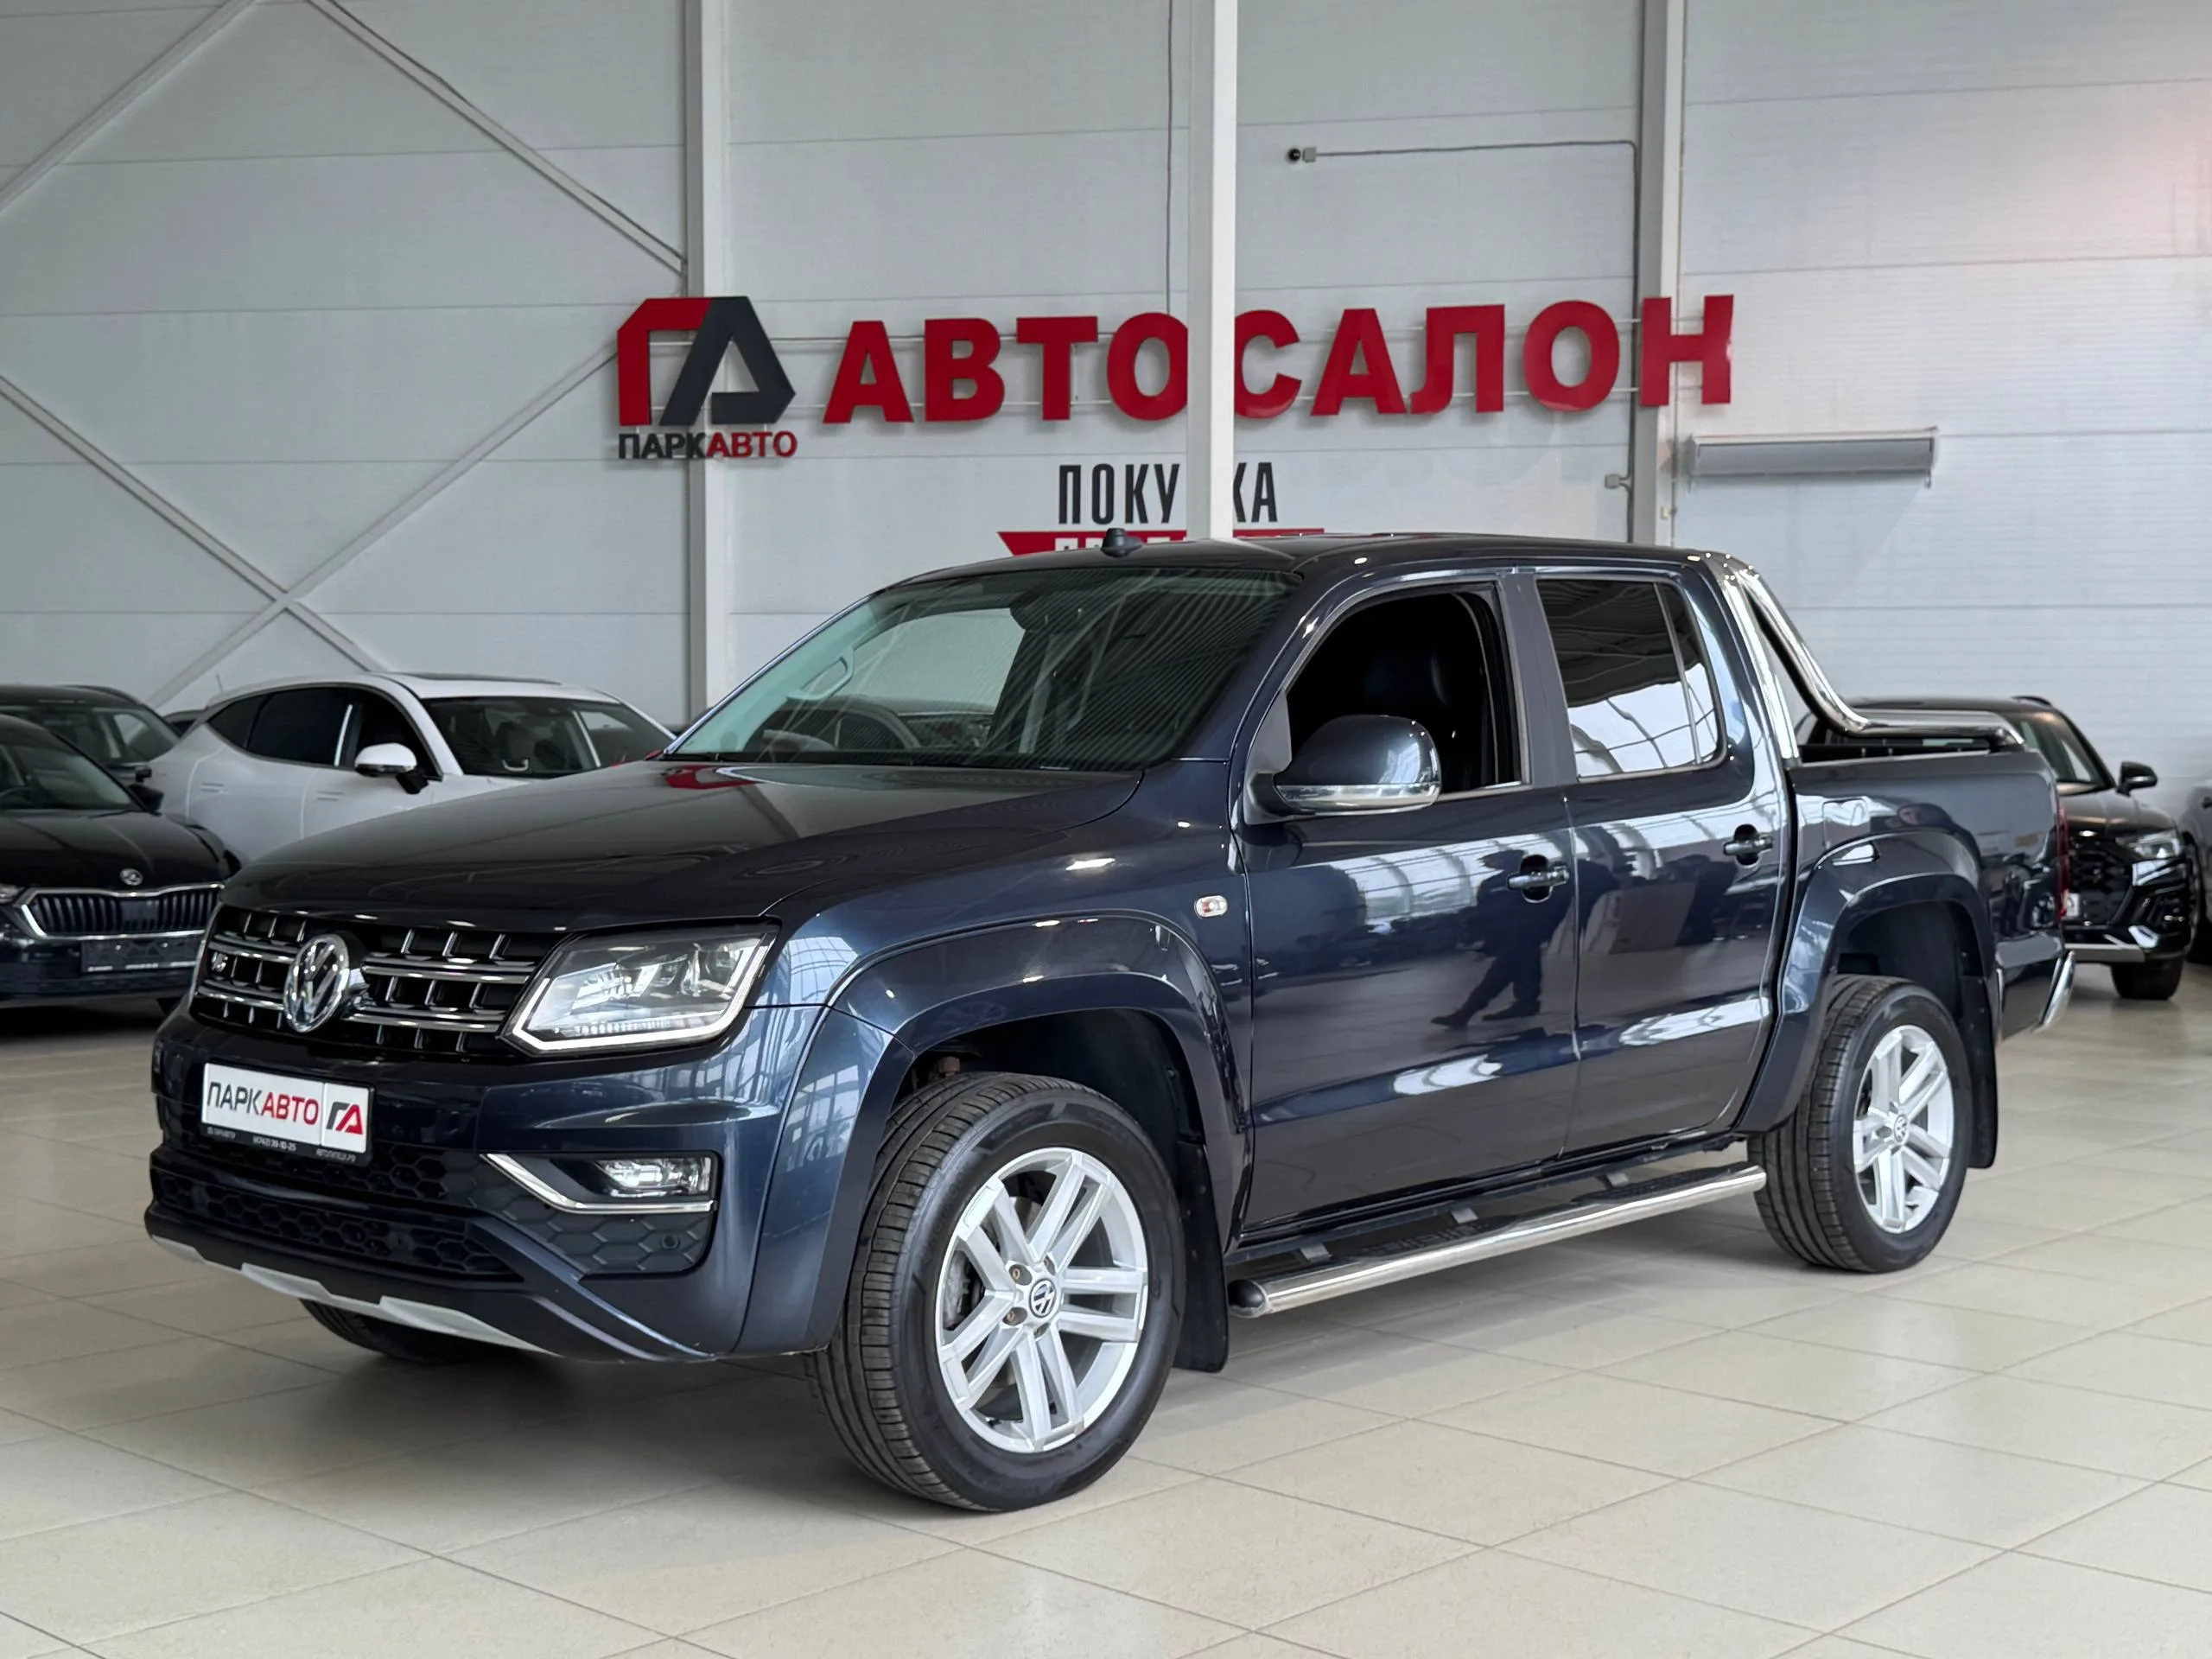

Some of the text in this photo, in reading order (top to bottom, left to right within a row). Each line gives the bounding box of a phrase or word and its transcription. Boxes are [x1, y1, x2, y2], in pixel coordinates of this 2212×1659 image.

[823, 294, 1734, 423] АВТОСАЛОН
[618, 430, 798, 460] ПАРКАВТО
[1058, 461, 1278, 524] ПОКУКА
[207, 1081, 320, 1125] ПАРКАВТО
